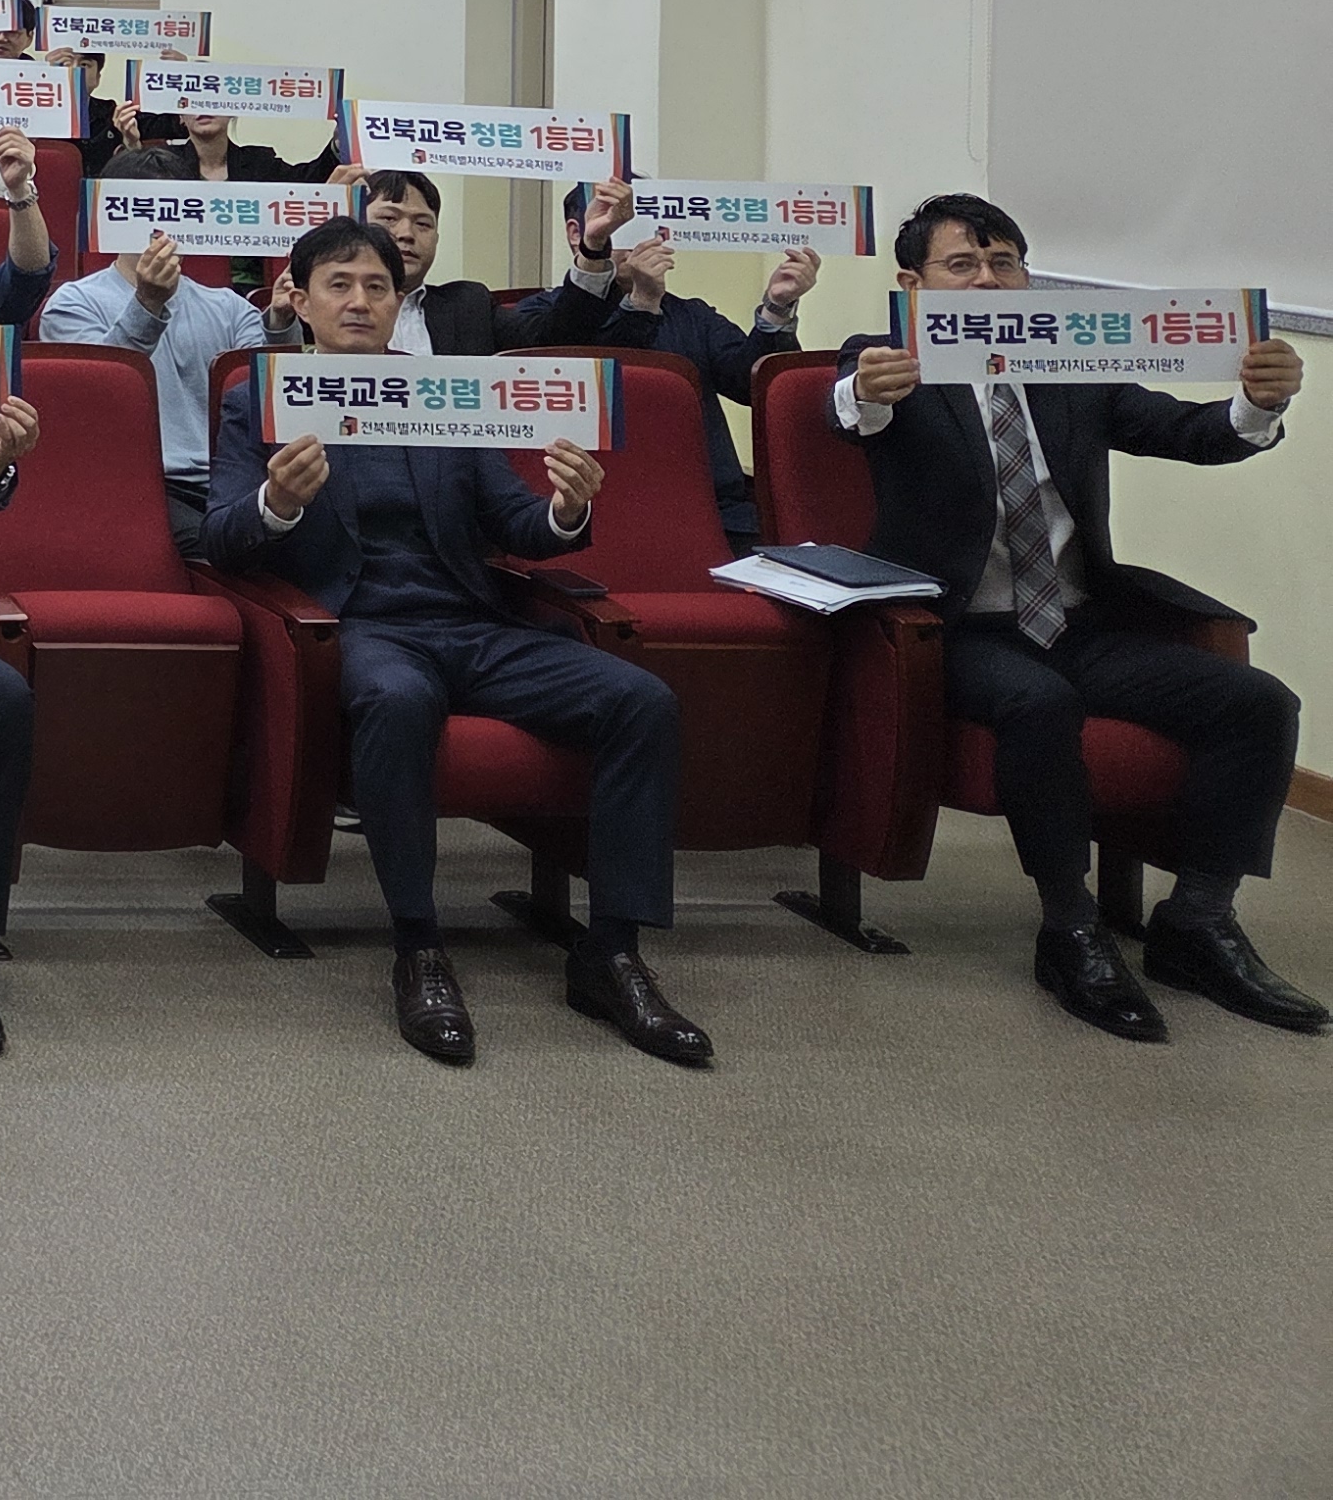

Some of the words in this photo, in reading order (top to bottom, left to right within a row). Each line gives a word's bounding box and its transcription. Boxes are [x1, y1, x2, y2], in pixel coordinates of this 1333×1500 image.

[52, 18, 115, 34] 전북교육
[118, 20, 148, 35] 청렴
[154, 15, 195, 38] 1등급!
[1, 72, 62, 107] 1등급!
[146, 73, 220, 93] 전북교육
[224, 77, 262, 96] 청렴
[268, 72, 321, 98] 1등급!
[365, 117, 466, 145] 전북교육
[471, 122, 522, 149] 청렴
[530, 117, 603, 152] 1등급!
[105, 197, 205, 223] 전북교육
[210, 198, 260, 225] 청렴
[635, 196, 711, 220] 북교육
[716, 197, 767, 223] 청렴
[776, 190, 846, 225] 1등급!
[926, 313, 1059, 345] 전북교육
[1066, 312, 1130, 345] 청렴
[1141, 300, 1236, 344] 1등급!
[1008, 358, 1184, 372] 전북특별자치도무주교육지원청
[283, 376, 410, 408] 전북교육
[416, 377, 480, 410] 청렴
[491, 367, 586, 412] 1등급!
[361, 421, 533, 438] 전북특별자치도무주교육지원청
